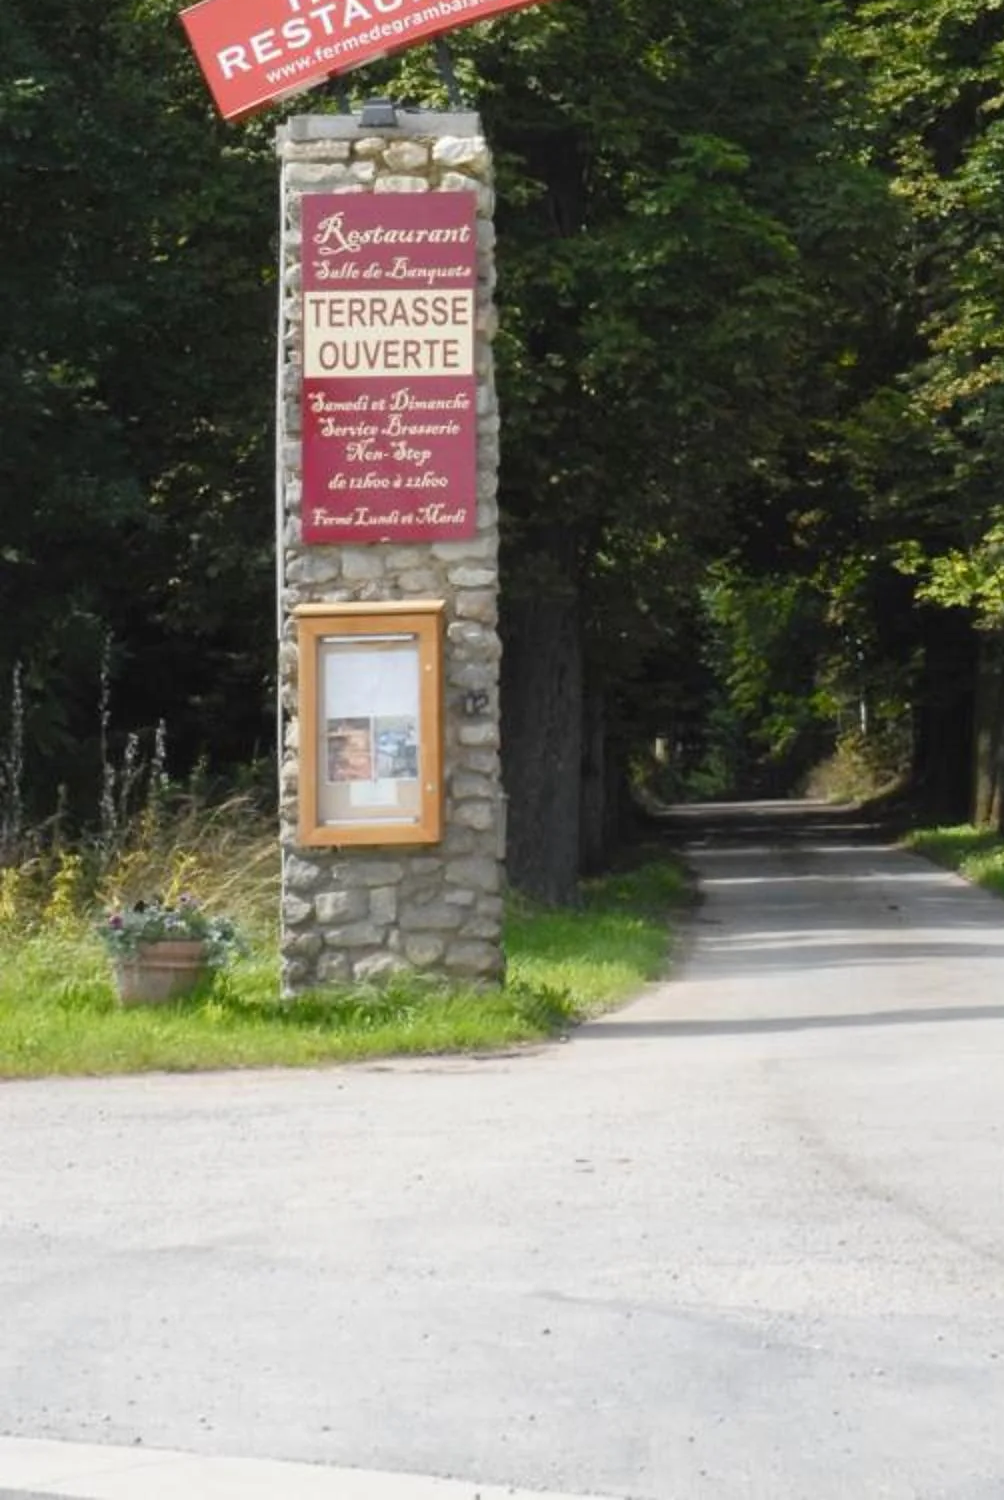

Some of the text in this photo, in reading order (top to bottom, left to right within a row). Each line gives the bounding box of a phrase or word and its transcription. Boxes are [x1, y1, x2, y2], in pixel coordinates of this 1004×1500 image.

[312, 211, 471, 255] Restaurant
[312, 256, 472, 285] Salle de Banquets
[309, 296, 469, 328] TERRASSE
[318, 339, 460, 370] OUVERTE
[308, 387, 470, 412] Samedi et Dimanche
[318, 413, 461, 437] Service Brasserie
[328, 473, 347, 490] de
[393, 474, 403, 488] à
[354, 508, 399, 526] Lundi
[401, 512, 413, 524] et
[415, 504, 467, 524] Mardi
